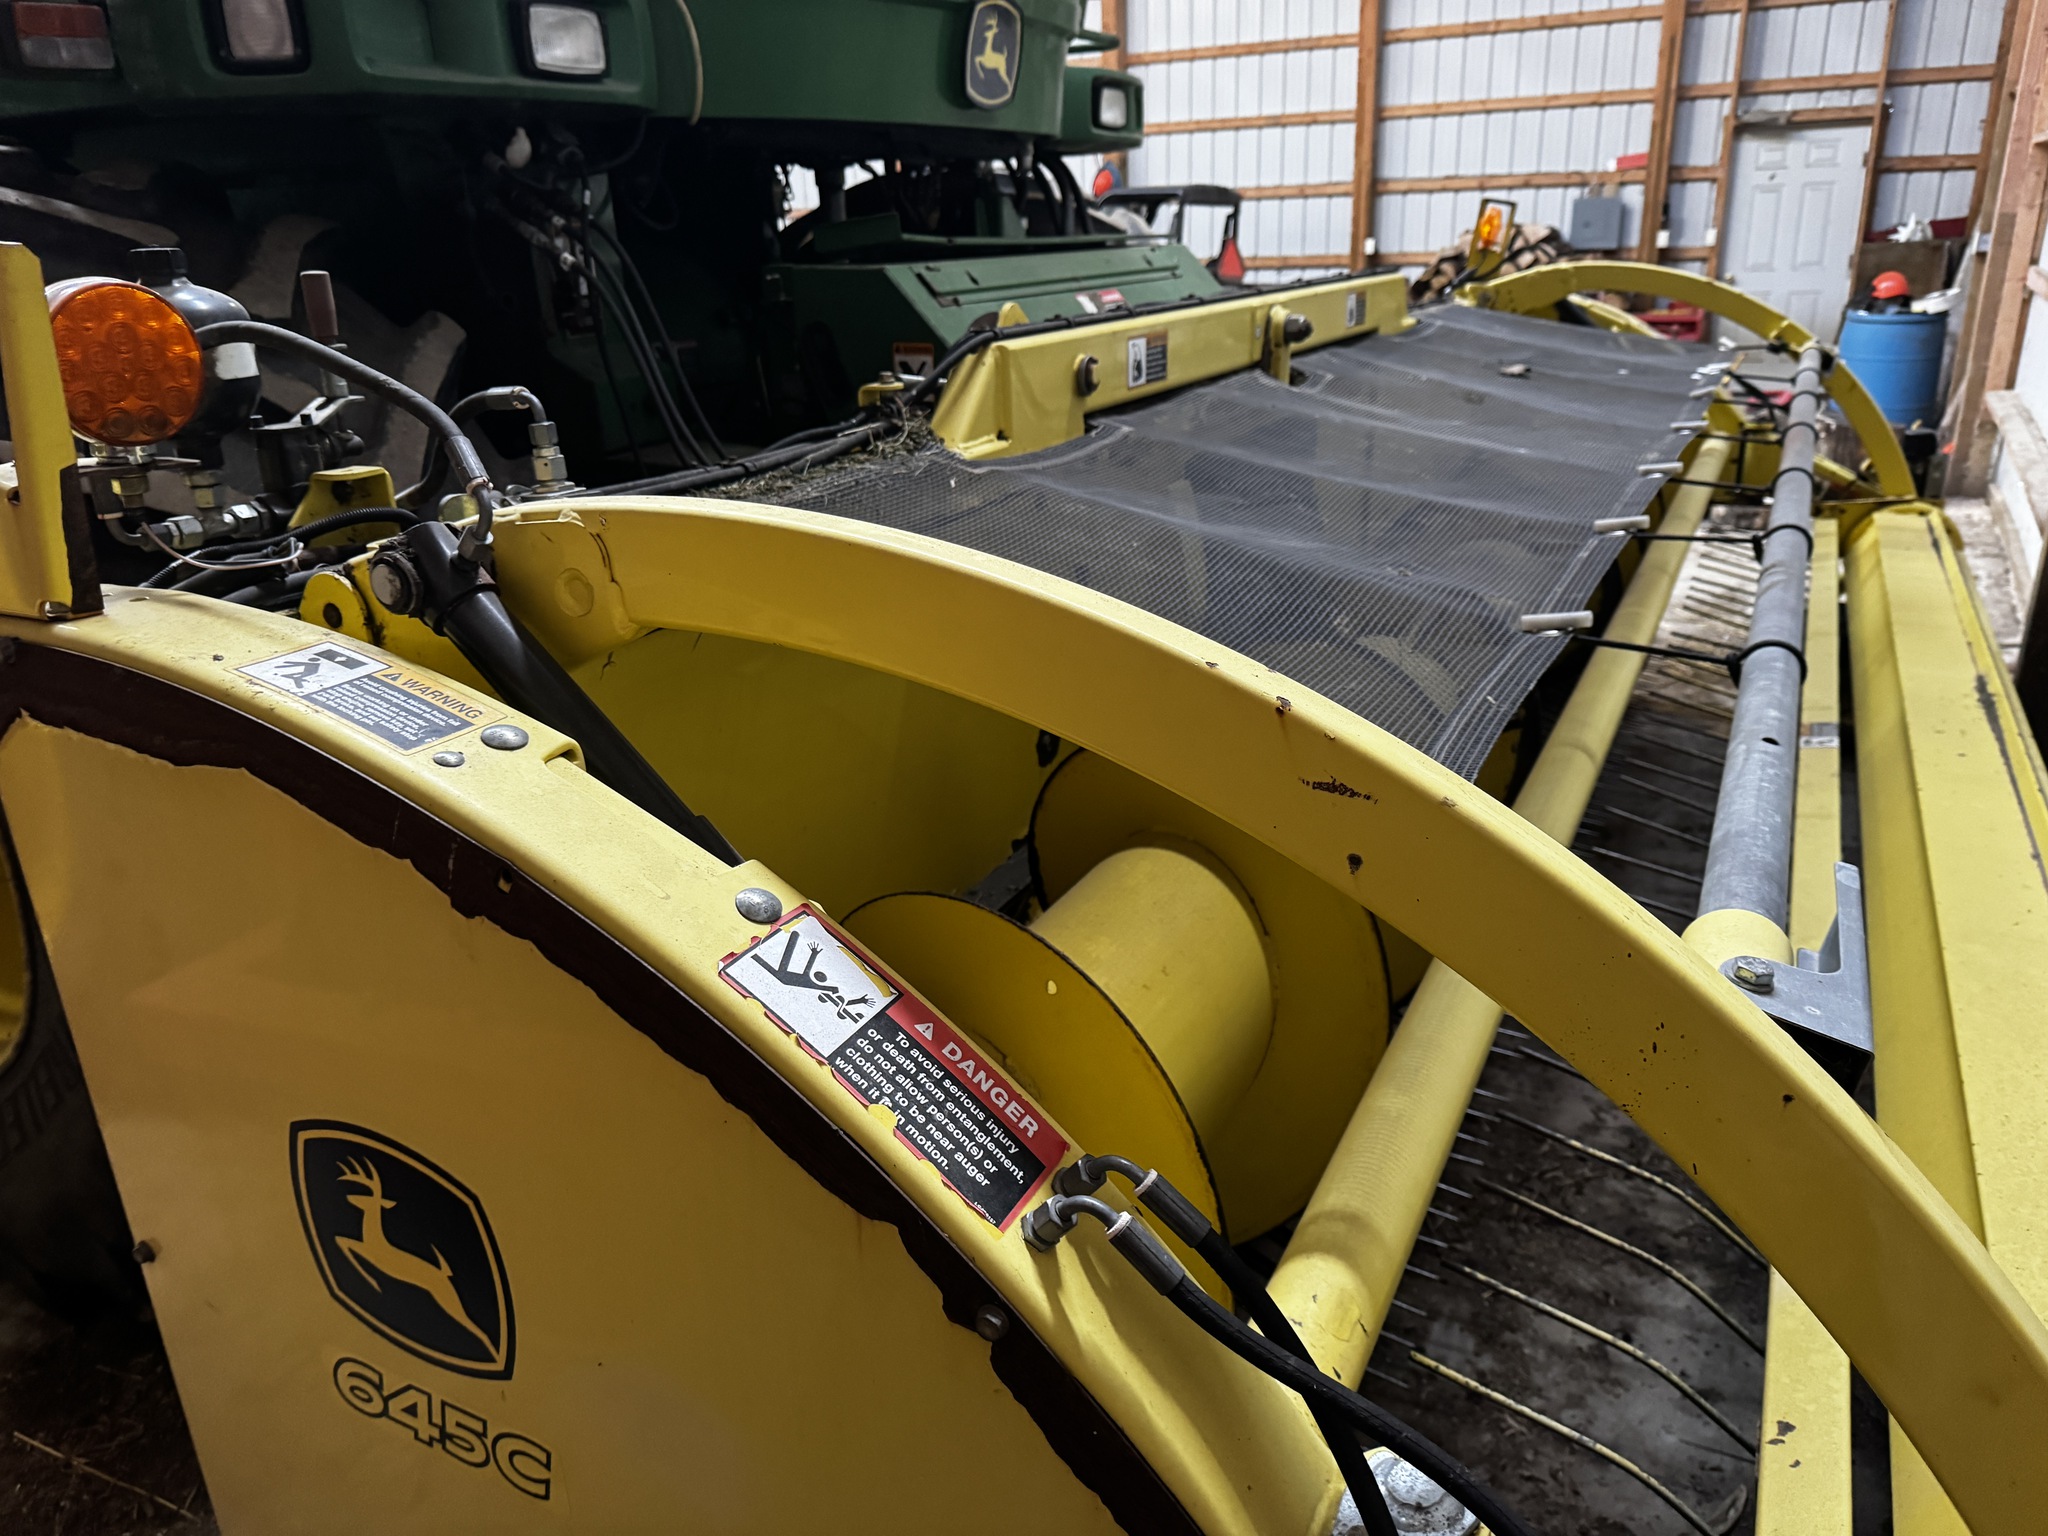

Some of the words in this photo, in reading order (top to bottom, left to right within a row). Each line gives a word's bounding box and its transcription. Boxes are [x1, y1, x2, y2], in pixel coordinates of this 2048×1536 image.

[402, 678, 483, 719] WARNING
[835, 1057, 868, 1089] when
[868, 1087, 880, 1099] it
[893, 1109, 906, 1125] in
[906, 1125, 948, 1170] motion.
[846, 1048, 894, 1094] clothing
[895, 1092, 908, 1106] to
[909, 1105, 925, 1123] be
[926, 1124, 955, 1150] near
[954, 1152, 990, 1186] auger
[857, 1039, 873, 1053] do
[874, 1054, 896, 1074] not
[895, 1075, 928, 1104] allow
[926, 1105, 983, 1159] person(s)
[984, 1160, 998, 1172] or
[868, 1029, 883, 1040] or
[883, 1043, 916, 1074] death
[917, 1073, 945, 1101] from
[945, 1102, 1023, 1183] entanglement,
[896, 1032, 909, 1047] To
[910, 1049, 944, 1079] avoid
[943, 1080, 985, 1120] serious
[986, 1119, 1019, 1153] injury
[942, 1042, 1038, 1138] DANGER
[333, 1357, 551, 1500] 645C
